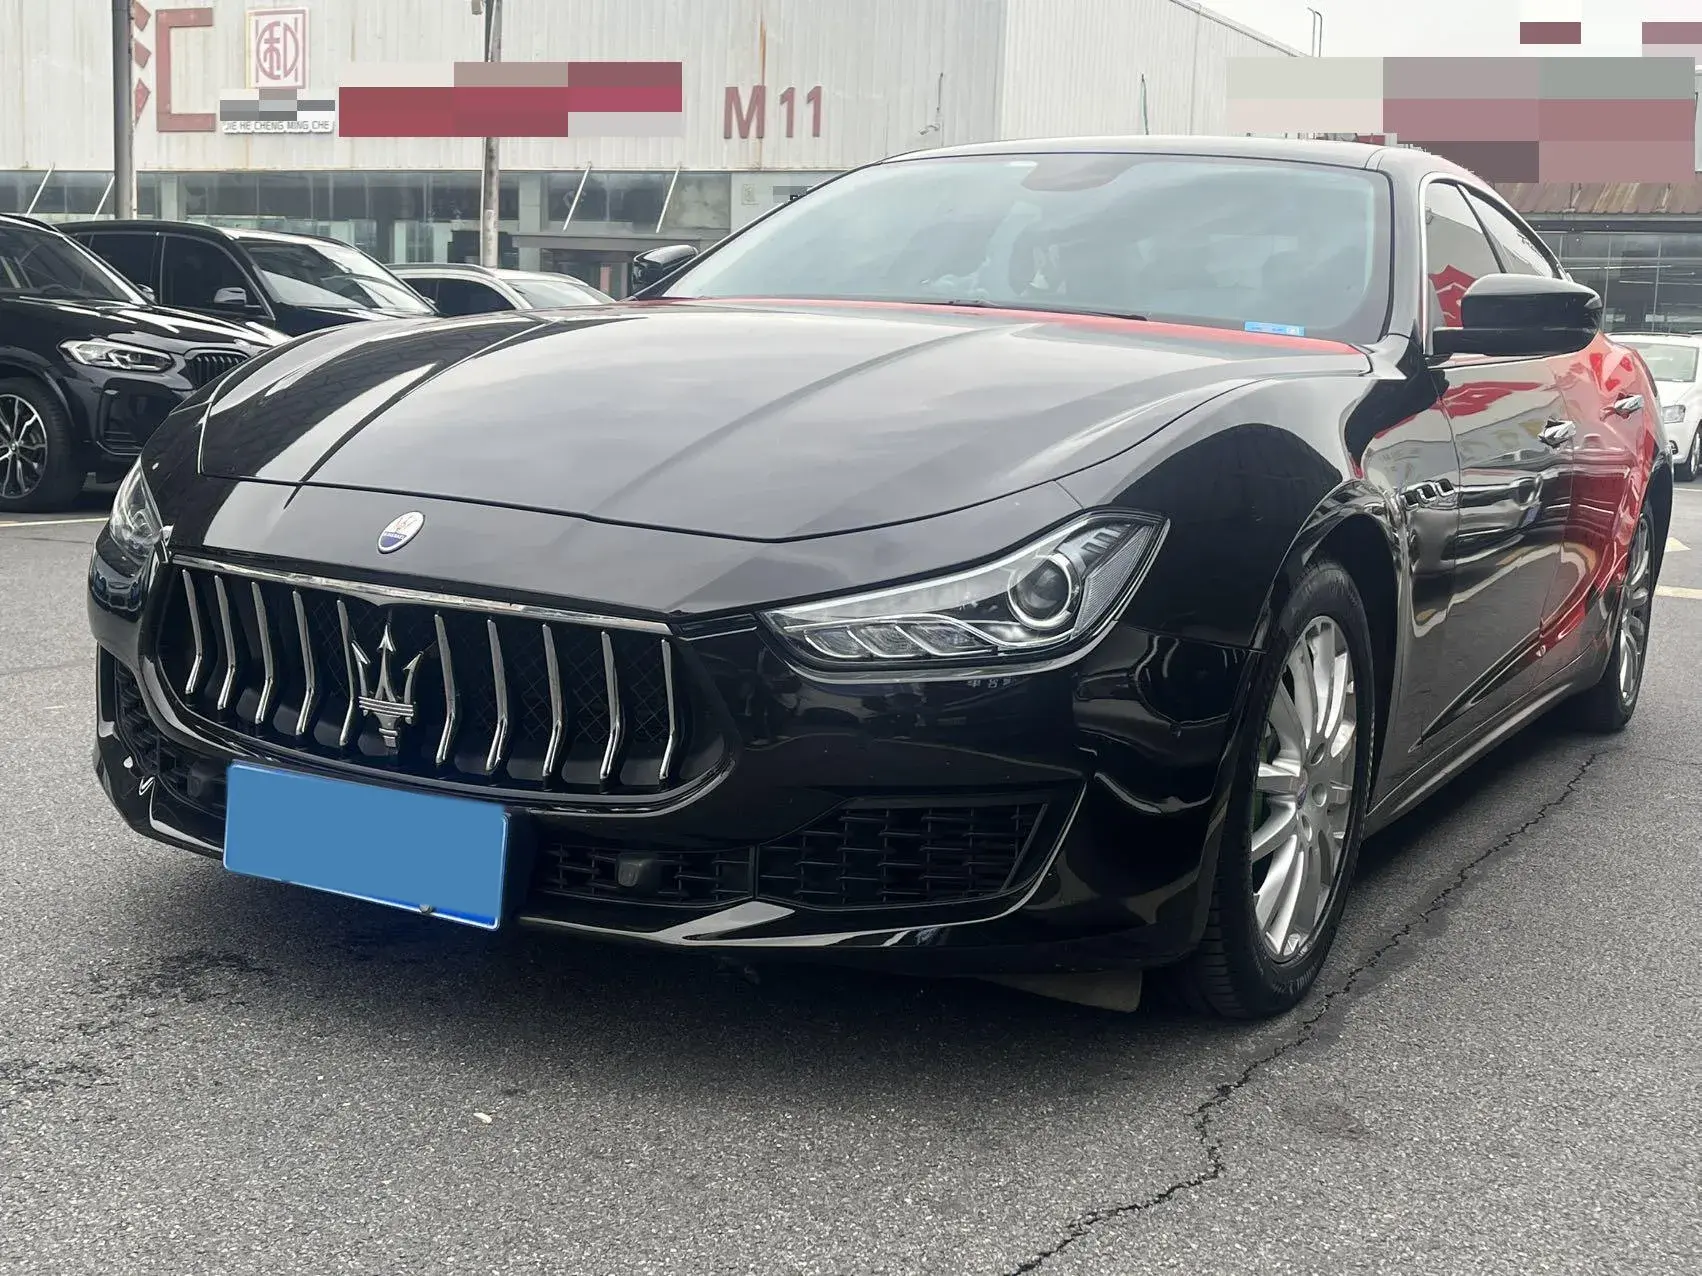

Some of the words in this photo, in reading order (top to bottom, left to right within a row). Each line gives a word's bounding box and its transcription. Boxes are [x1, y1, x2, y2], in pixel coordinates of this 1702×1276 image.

[240, 120, 251, 131] HE
[254, 120, 284, 131] CHENG
[311, 120, 330, 131] CHE
[723, 84, 822, 139] M11
